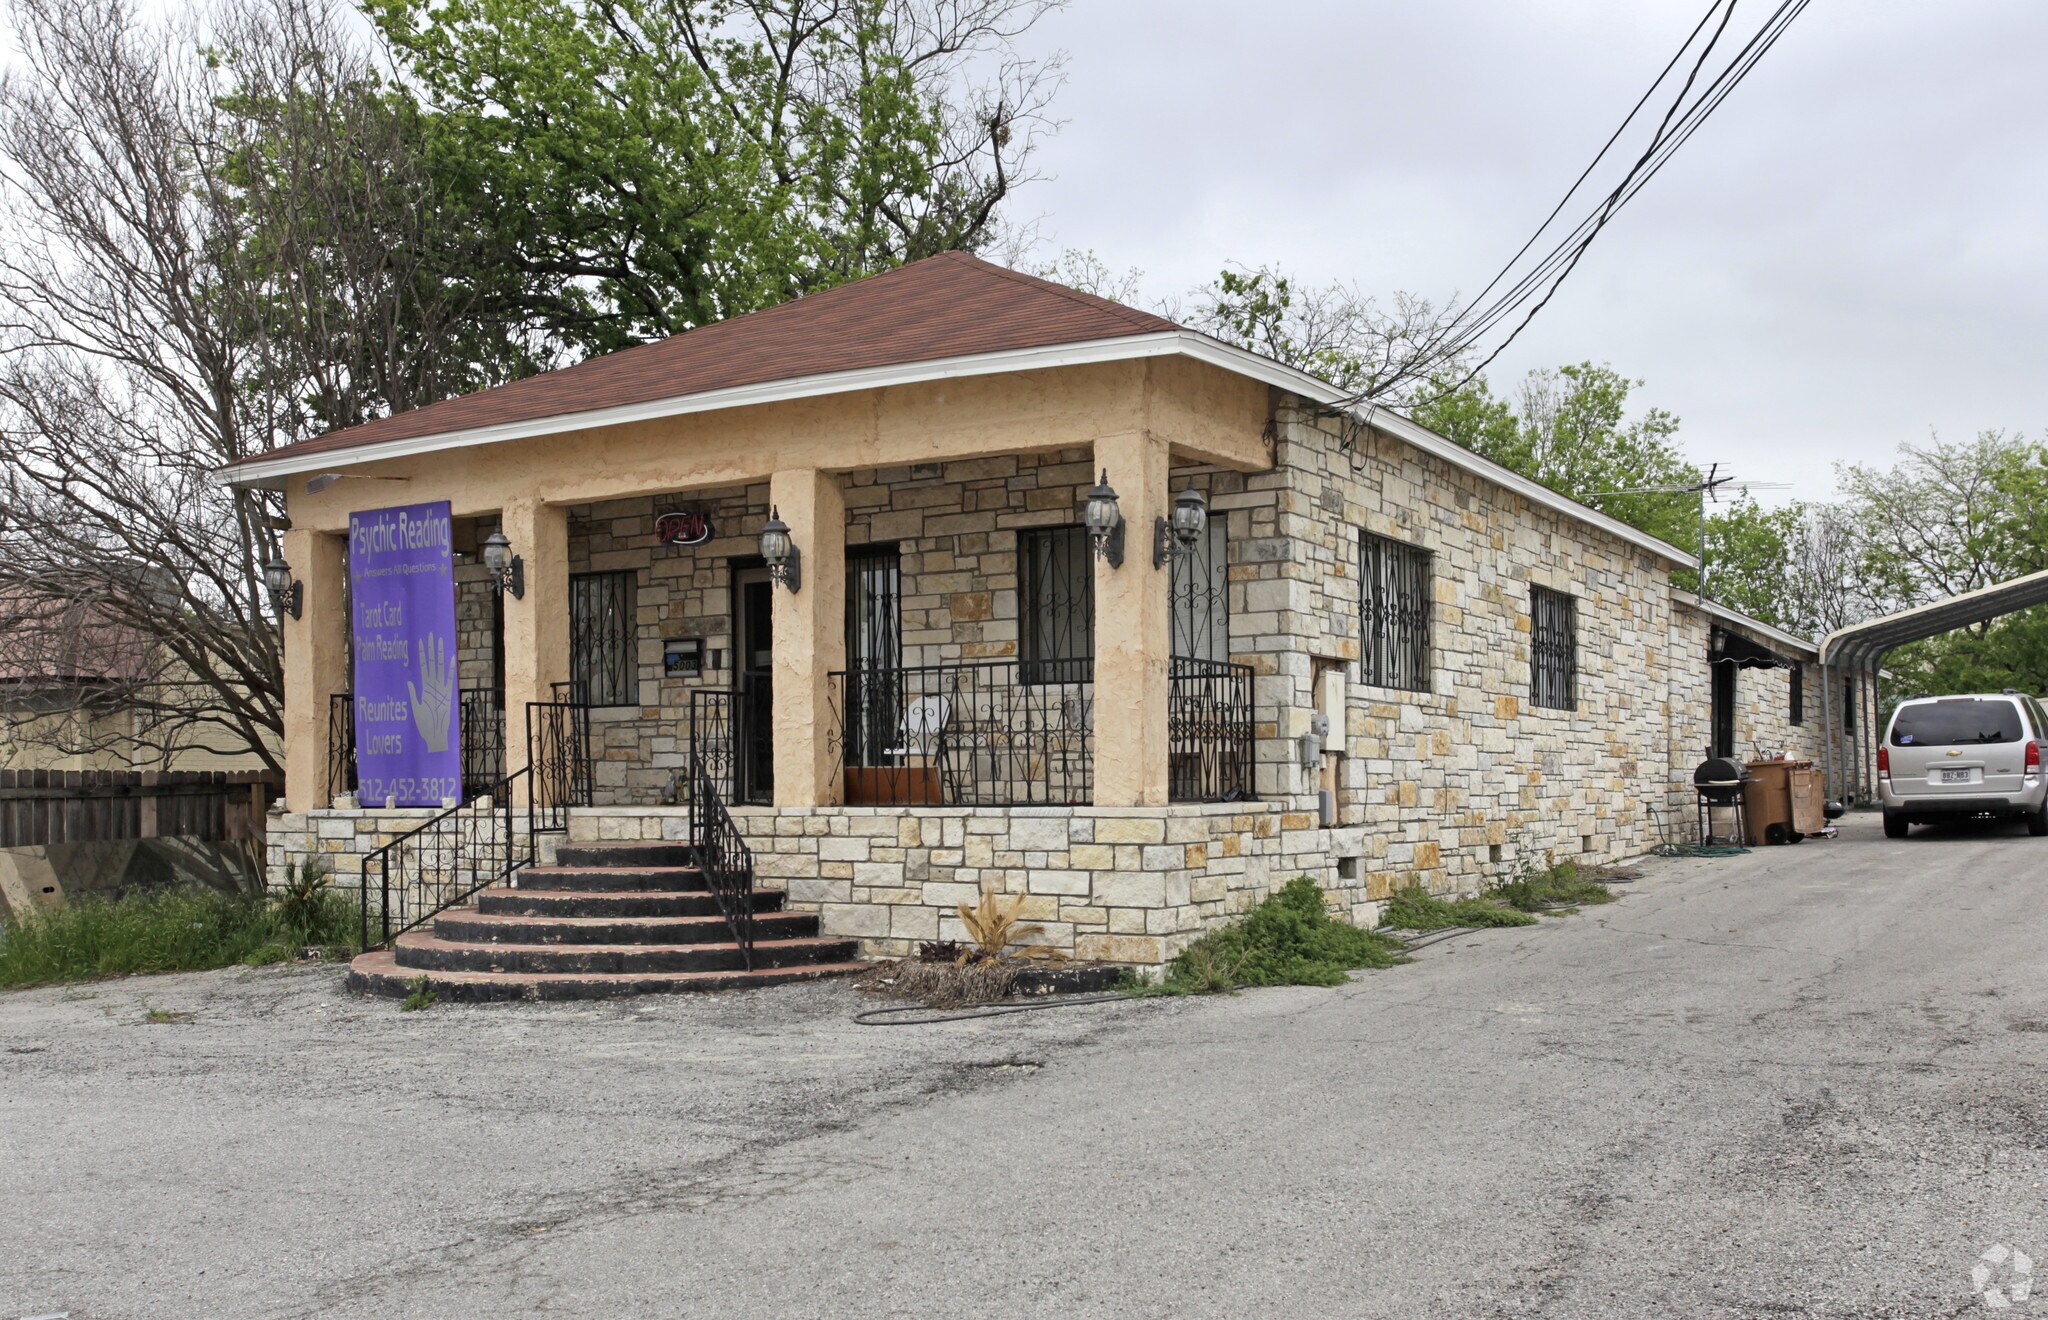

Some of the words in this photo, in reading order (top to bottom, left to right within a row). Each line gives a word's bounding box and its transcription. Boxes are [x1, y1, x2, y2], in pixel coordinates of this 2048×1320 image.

[352, 513, 397, 564] Psychic
[399, 508, 450, 557] Reading
[655, 512, 704, 543] OPEN
[364, 567, 393, 578] Answers
[393, 564, 402, 575] All
[402, 563, 437, 576] Questions
[360, 602, 382, 628] Tarot
[383, 600, 402, 627] Card
[356, 635, 375, 661] Palm
[376, 633, 409, 668] Reading
[673, 659, 697, 671] 5003
[359, 695, 408, 722] Reunites
[366, 729, 402, 754] Lovers
[359, 777, 457, 802] 512-452-3812
